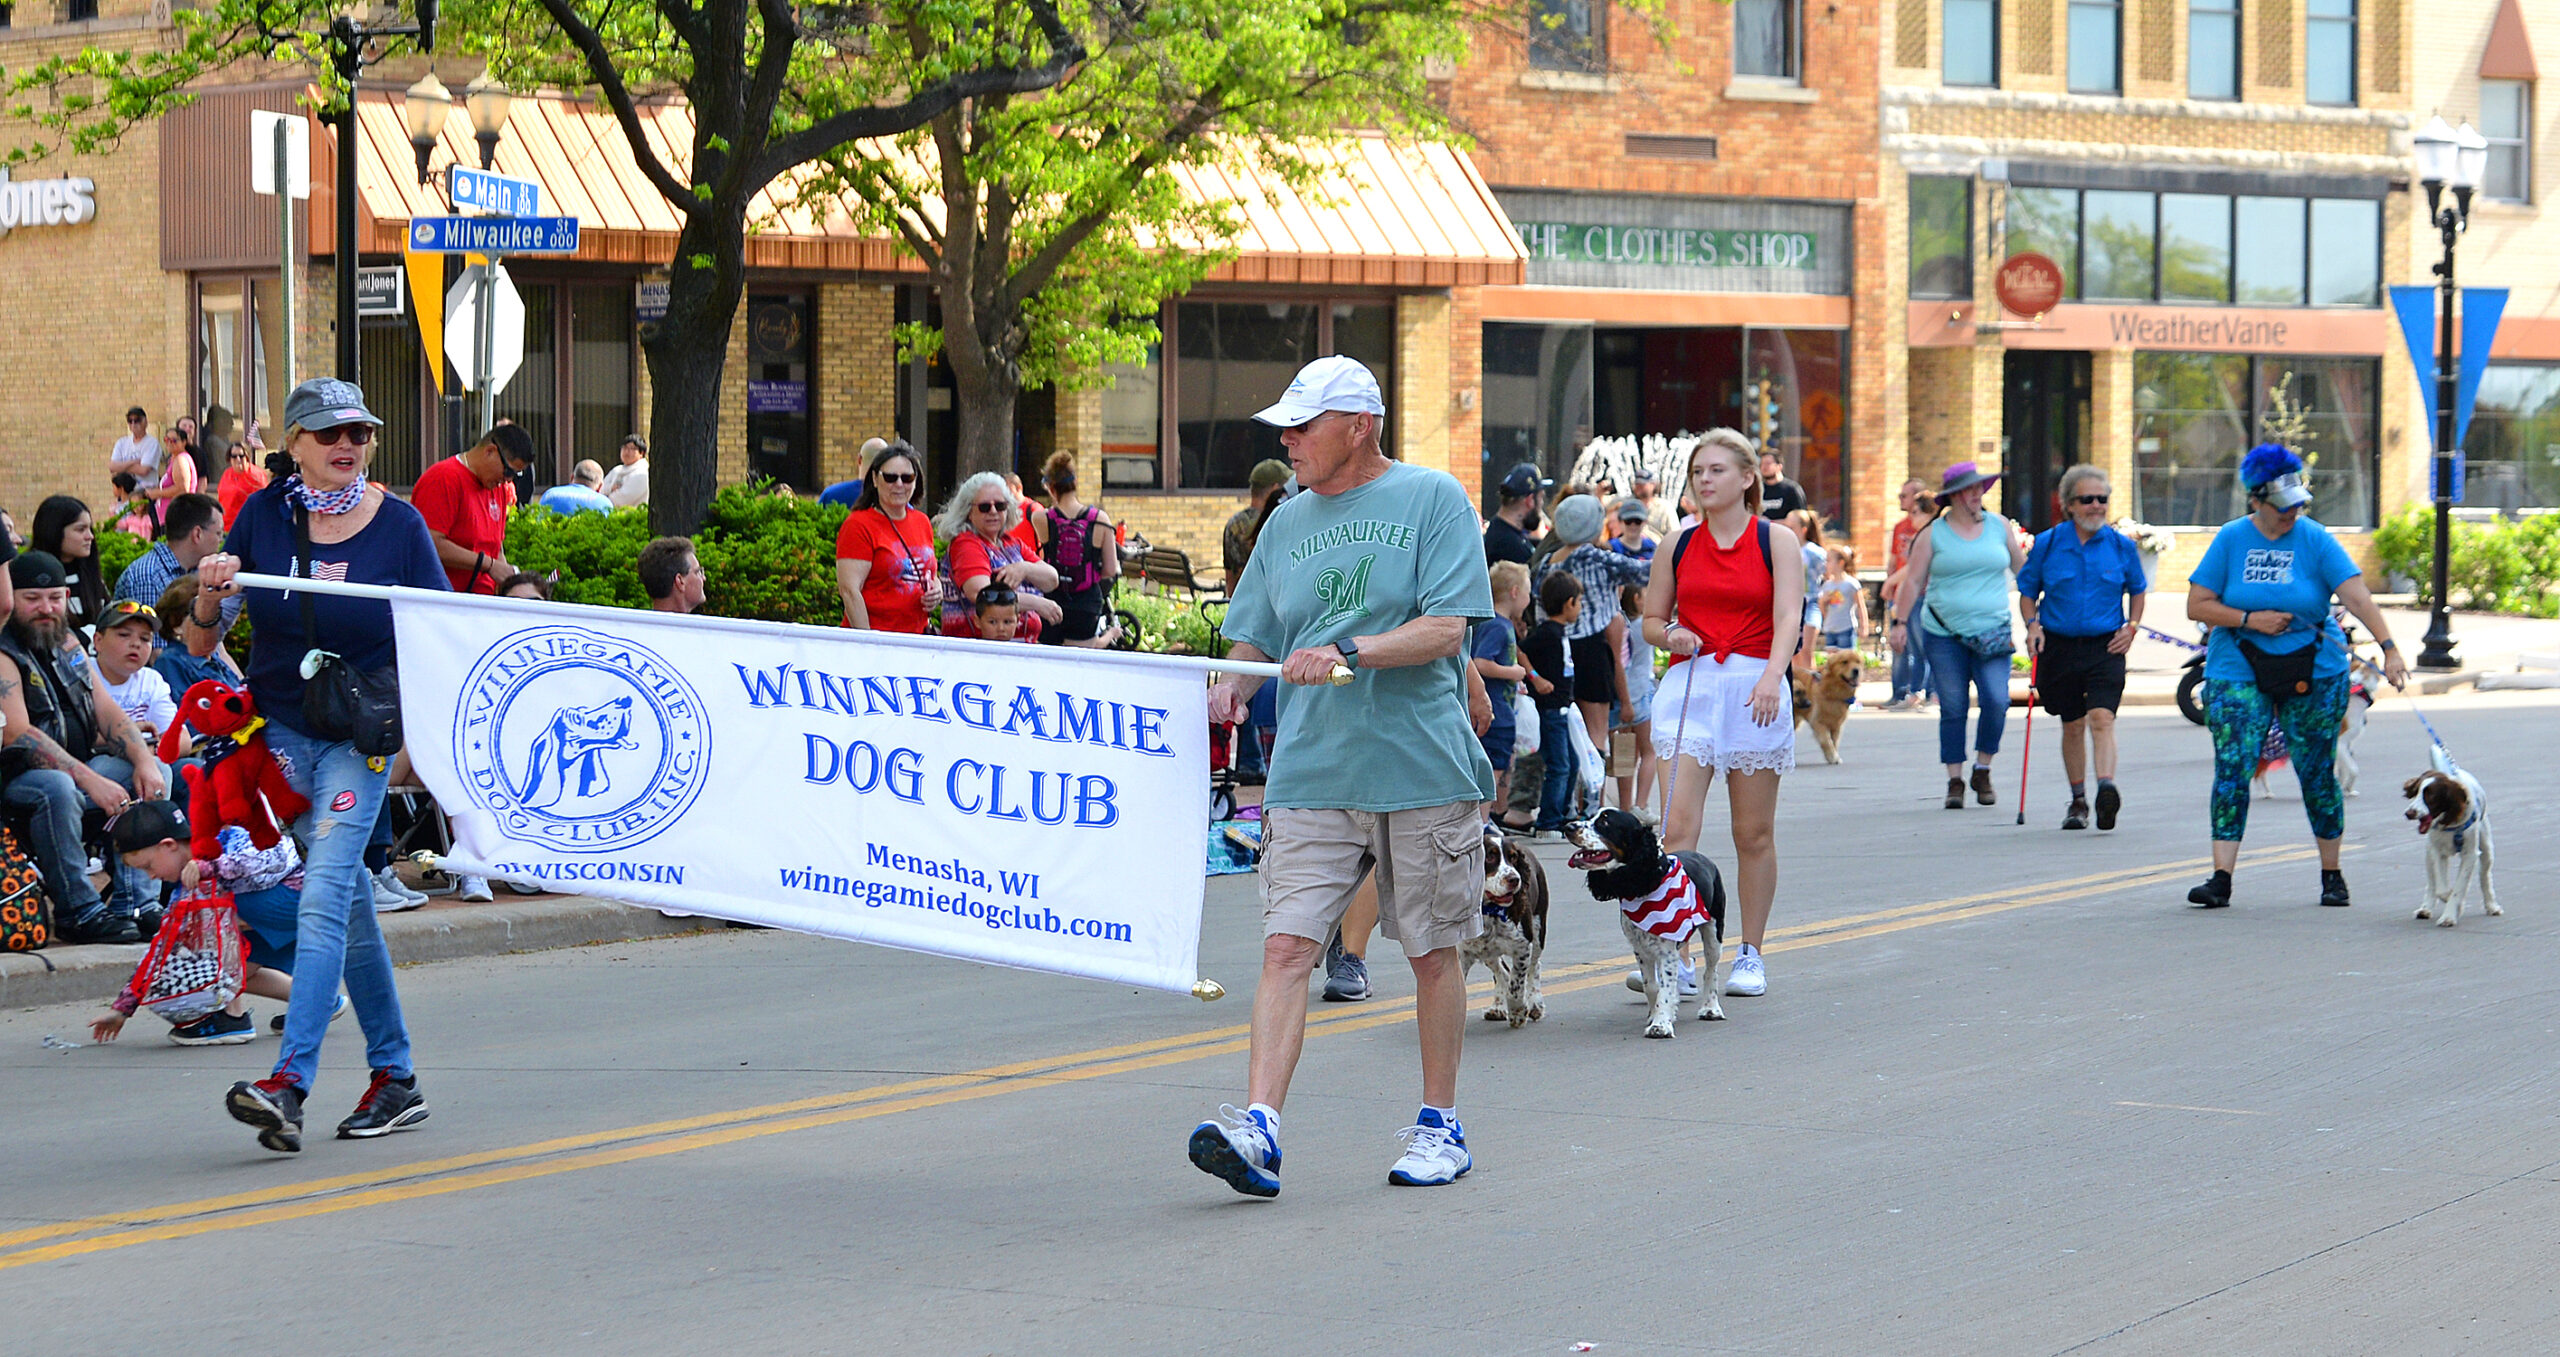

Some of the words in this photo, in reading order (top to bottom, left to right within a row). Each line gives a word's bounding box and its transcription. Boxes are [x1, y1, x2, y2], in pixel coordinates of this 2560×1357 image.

[475, 174, 512, 211] Main
[519, 183, 530, 197] St
[516, 196, 532, 215] 100
[444, 219, 544, 248] Milwaukee
[556, 218, 570, 234] St
[550, 232, 574, 248] 000
[1514, 223, 1567, 261] THE
[1584, 225, 1719, 266] CLOTHES
[1730, 231, 1810, 268] SHOP
[2109, 311, 2288, 347] WeatherVane
[1289, 519, 1416, 570] MILWAUKEE
[2246, 569, 2279, 582] SIDE
[469, 637, 692, 728] WINNEGAMIE
[731, 661, 1177, 759] WINNEGAMIE
[473, 765, 531, 830] DOG
[650, 749, 697, 812] INC.
[803, 732, 926, 806] DOG
[945, 757, 1120, 830] CLUB
[523, 862, 685, 885] WISCONSIN
[865, 842, 993, 893] Menasha,
[998, 869, 1040, 899] WI
[779, 866, 1133, 943] winnegamiedogclub.com
